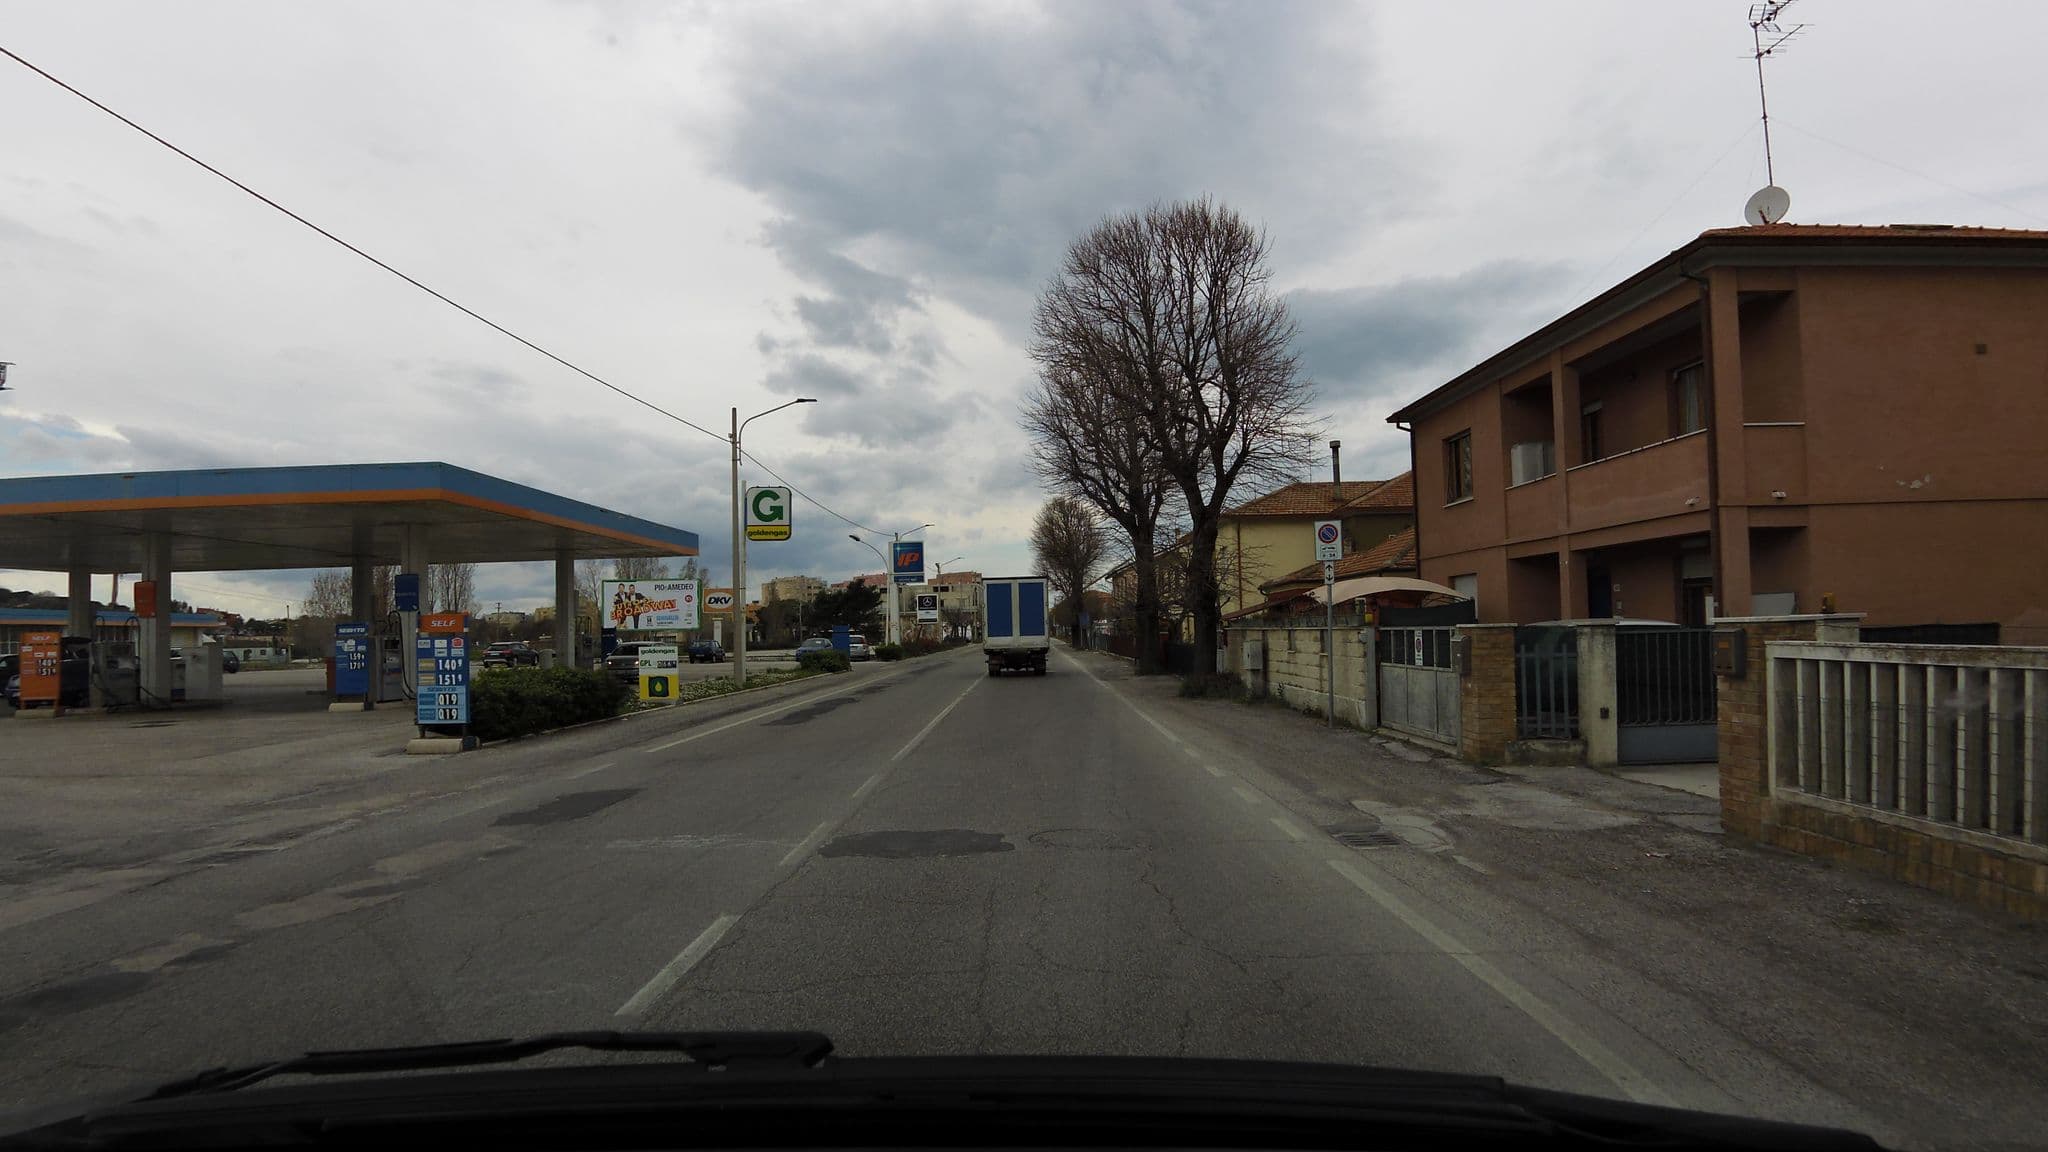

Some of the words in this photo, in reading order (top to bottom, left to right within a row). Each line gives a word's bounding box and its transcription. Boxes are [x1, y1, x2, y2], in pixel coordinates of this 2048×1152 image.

[752, 490, 784, 522] G
[748, 529, 788, 537] goldengas
[897, 552, 920, 568] IP
[708, 596, 732, 605] DKV
